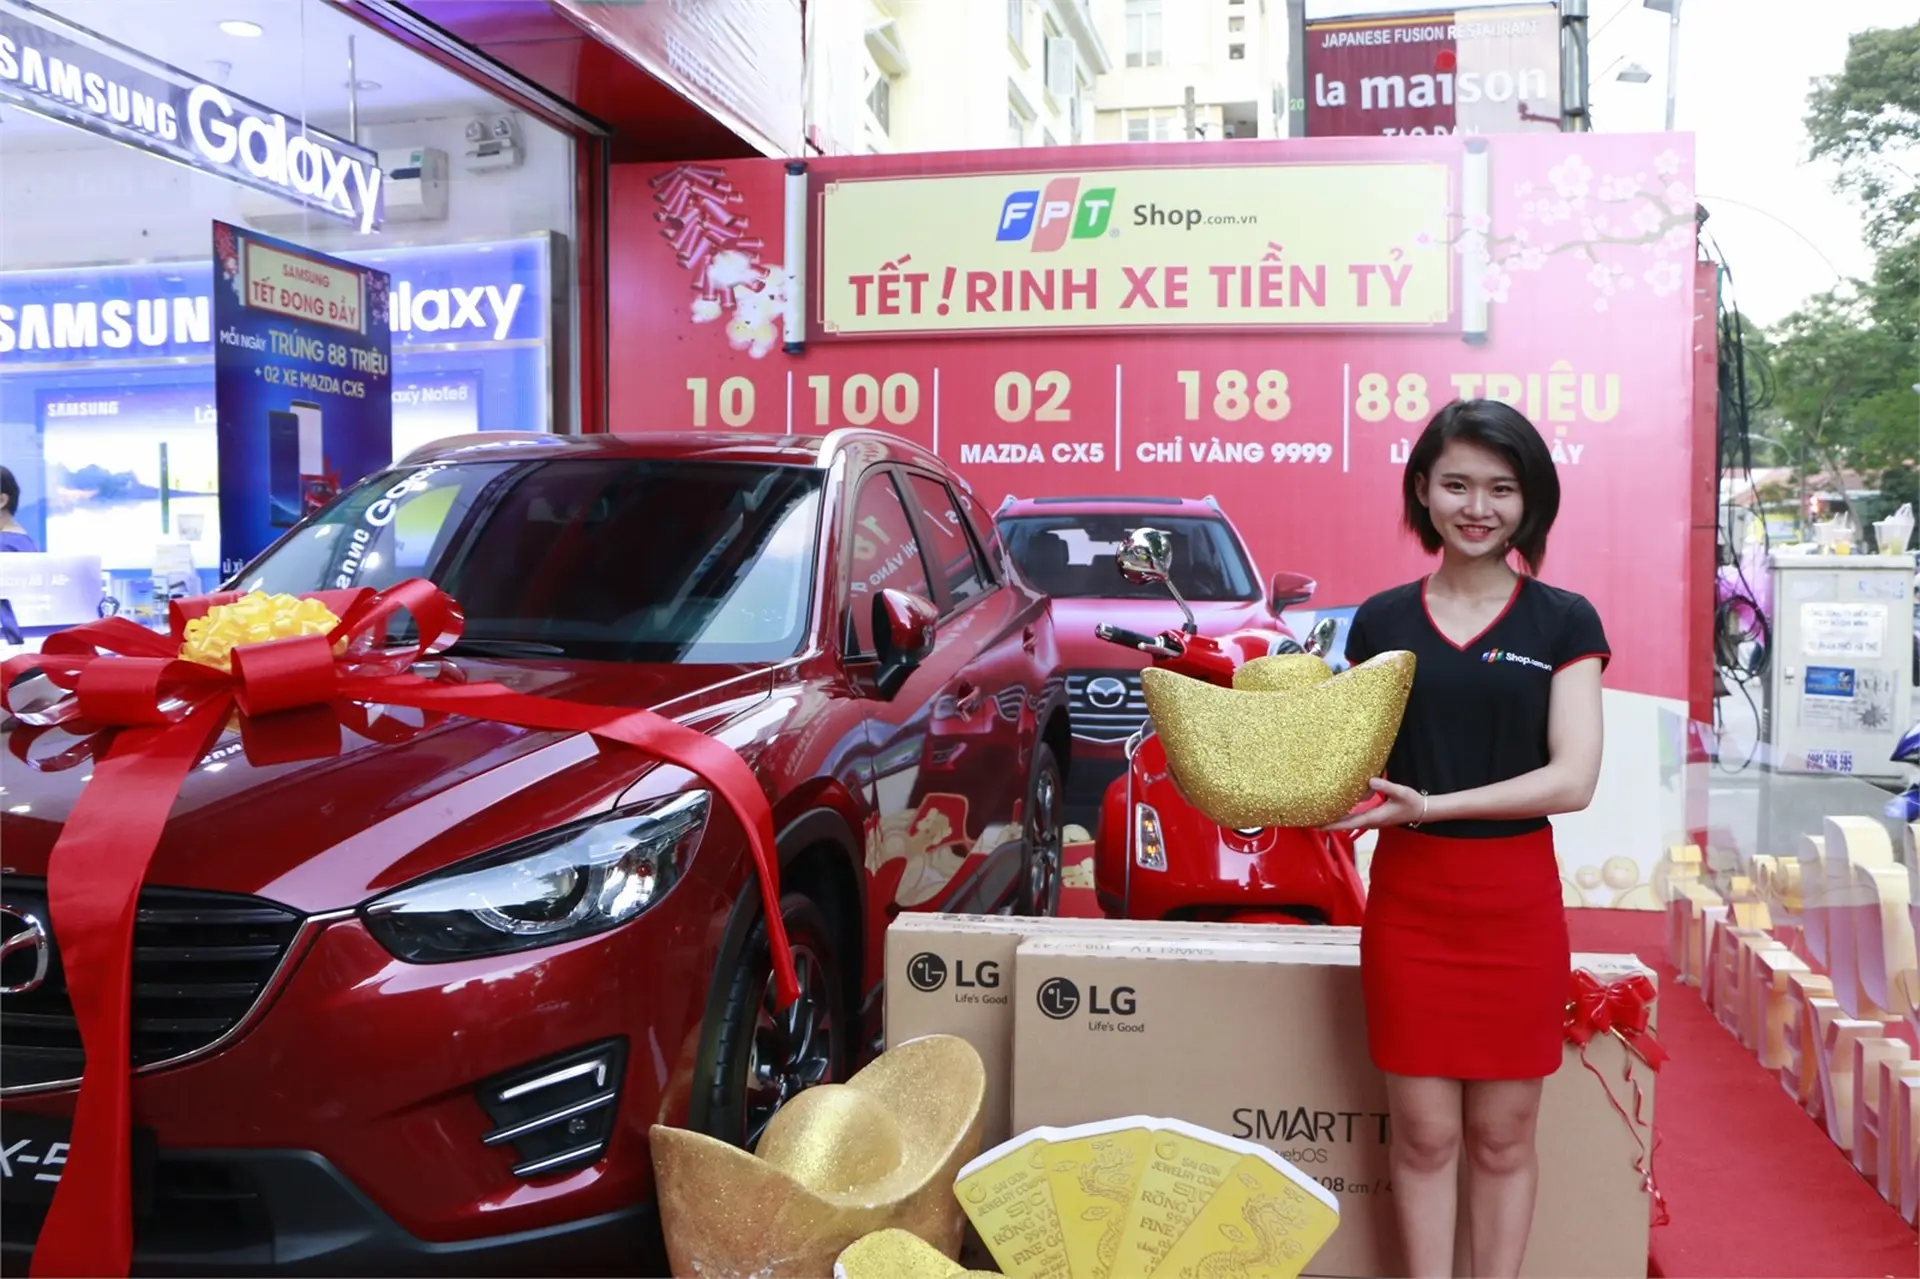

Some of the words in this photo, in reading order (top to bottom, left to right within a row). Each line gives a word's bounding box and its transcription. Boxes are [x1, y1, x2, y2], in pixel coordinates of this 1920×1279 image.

[1322, 29, 1390, 48] JAPANESE
[1395, 26, 1445, 44] FUSION
[1447, 20, 1538, 40] RESTAURANT
[1316, 73, 1346, 107] la
[1361, 49, 1547, 111] maison
[0, 34, 178, 142] SAMSUNG
[187, 84, 382, 234] Galaxy
[1133, 203, 1258, 230] Shop.com.vn
[282, 263, 330, 289] SAMSUNG
[966, 268, 1097, 313] RINH
[1119, 266, 1188, 309] XE
[1209, 240, 1327, 308] TIỀN
[1348, 247, 1414, 307] TỶ
[0, 296, 211, 353] SAMSUN
[389, 280, 526, 341] laxy
[268, 328, 325, 363] TRÚNG
[328, 344, 347, 368] 88
[264, 365, 280, 383] 02
[283, 370, 298, 387] XE
[300, 372, 340, 393] MAZDA
[342, 381, 365, 398] CX5
[994, 370, 1072, 422] 02
[1177, 369, 1291, 422] 188
[47, 401, 119, 417] SAMSUNG
[686, 376, 755, 427] 10
[808, 372, 919, 426] 100
[1355, 372, 1430, 423] 88
[960, 443, 1044, 464] MAZDA
[1051, 442, 1104, 464] CX5
[1136, 435, 1183, 463] CHỈ
[1189, 436, 1265, 463] VÀNG
[1271, 442, 1332, 463] 9999
[956, 960, 999, 988] LG
[955, 994, 979, 1004] Life's
[982, 994, 1008, 1005] Good
[1089, 986, 1137, 1015] LG
[1088, 1021, 1115, 1033] Life's
[1117, 1022, 1145, 1033] Good
[1232, 1107, 1362, 1143] SMART
[1369, 1113, 1390, 1144] T
[1348, 1183, 1368, 1194] cm
[1140, 1216, 1176, 1238] FINE
[1012, 1241, 1046, 1266] FINE
